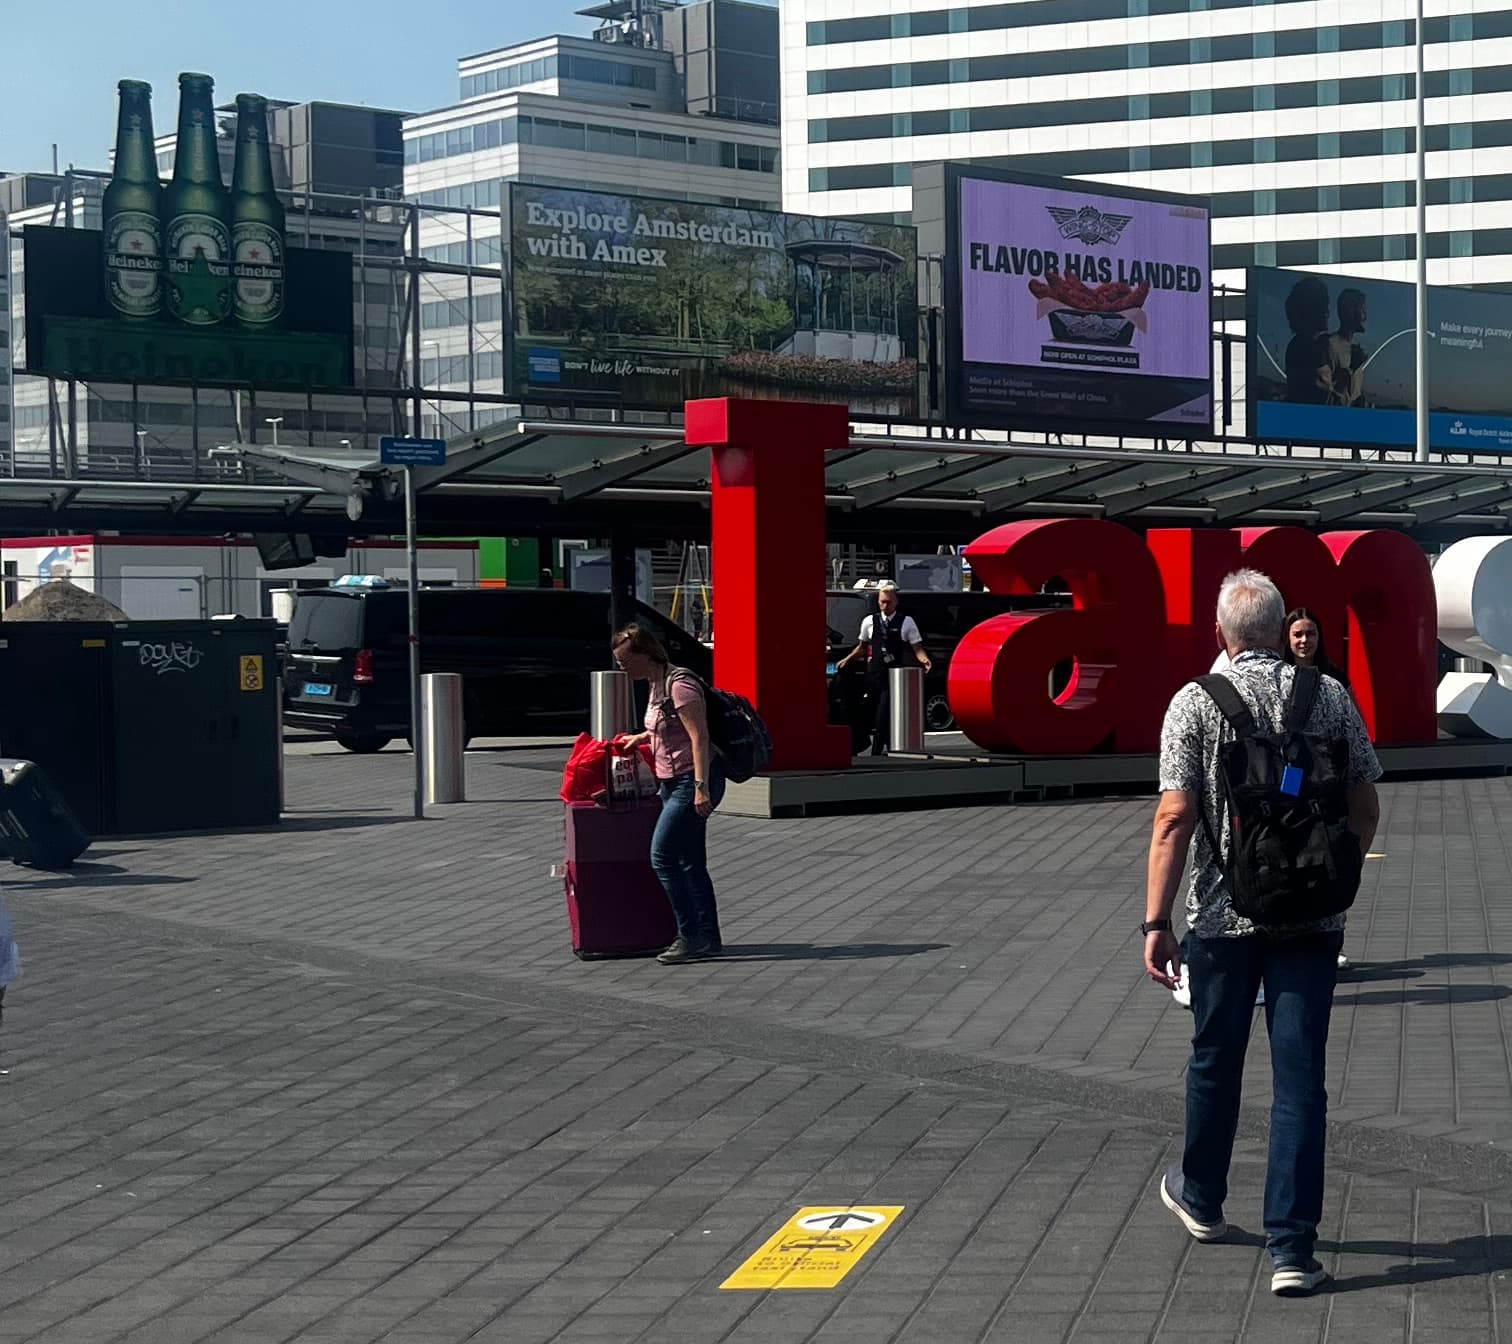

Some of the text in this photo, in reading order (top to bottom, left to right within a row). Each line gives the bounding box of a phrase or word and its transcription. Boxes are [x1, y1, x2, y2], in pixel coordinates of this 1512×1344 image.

[526, 201, 776, 249] Explore Amsterdam
[168, 259, 230, 277] Heiken
[526, 233, 667, 268] with Amex
[970, 242, 1203, 293] FLAVOR HAS LANDED
[1440, 321, 1461, 333] Make
[590, 358, 614, 374] live
[614, 359, 635, 377] life
[684, 396, 852, 771] I
